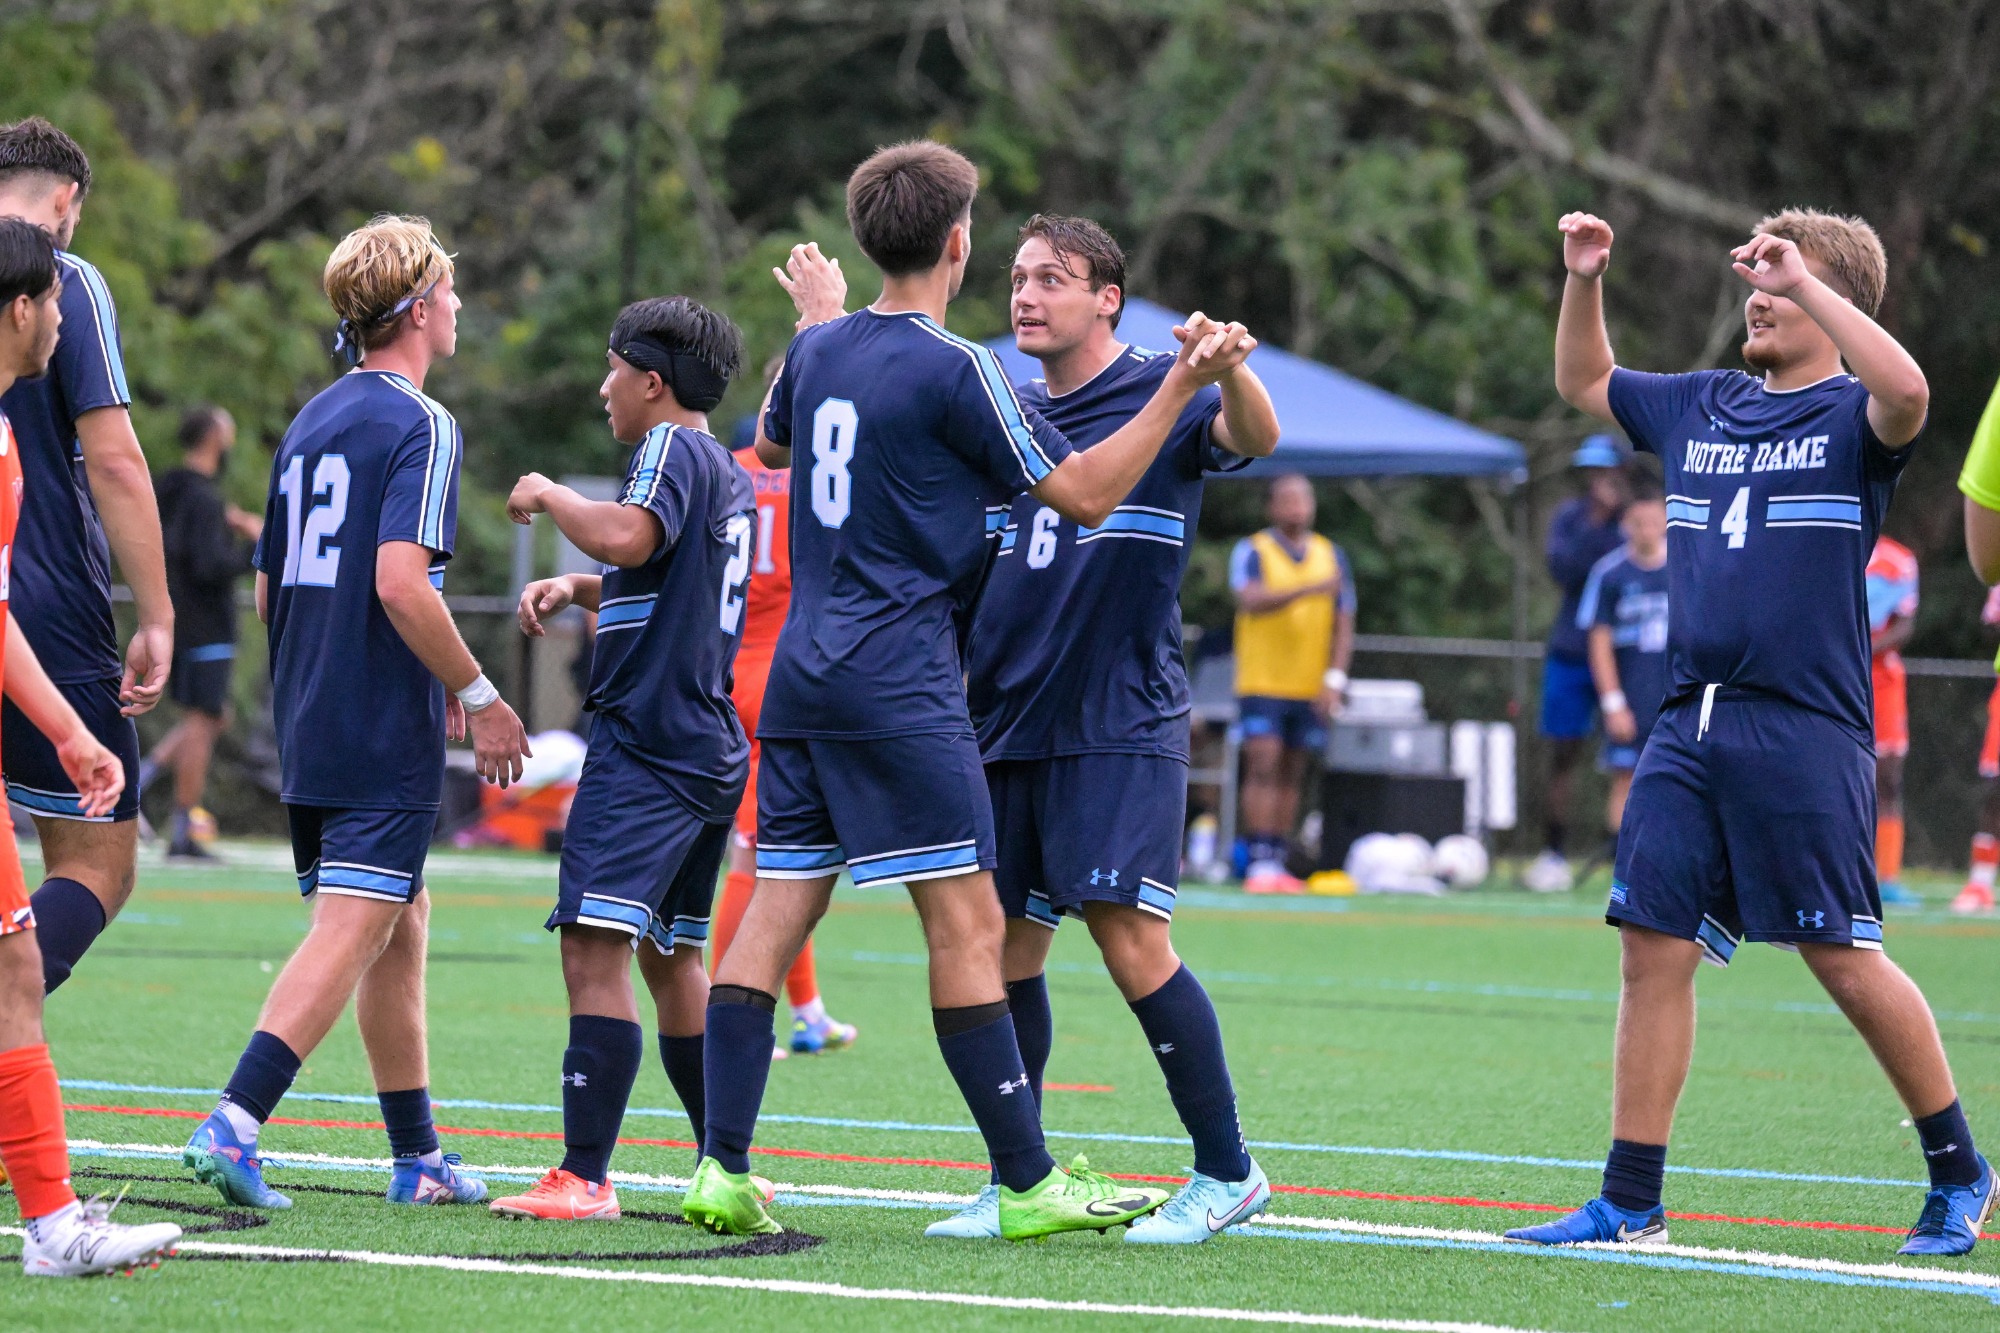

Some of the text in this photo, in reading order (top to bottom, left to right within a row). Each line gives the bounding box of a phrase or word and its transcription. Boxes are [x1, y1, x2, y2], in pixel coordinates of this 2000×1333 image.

[811, 397, 859, 529] 8
[1683, 435, 1829, 474] NOTRE DAME
[279, 454, 351, 588] 12
[1027, 506, 1060, 569] 6
[1721, 486, 1750, 549] 4
[719, 510, 751, 636] 2
